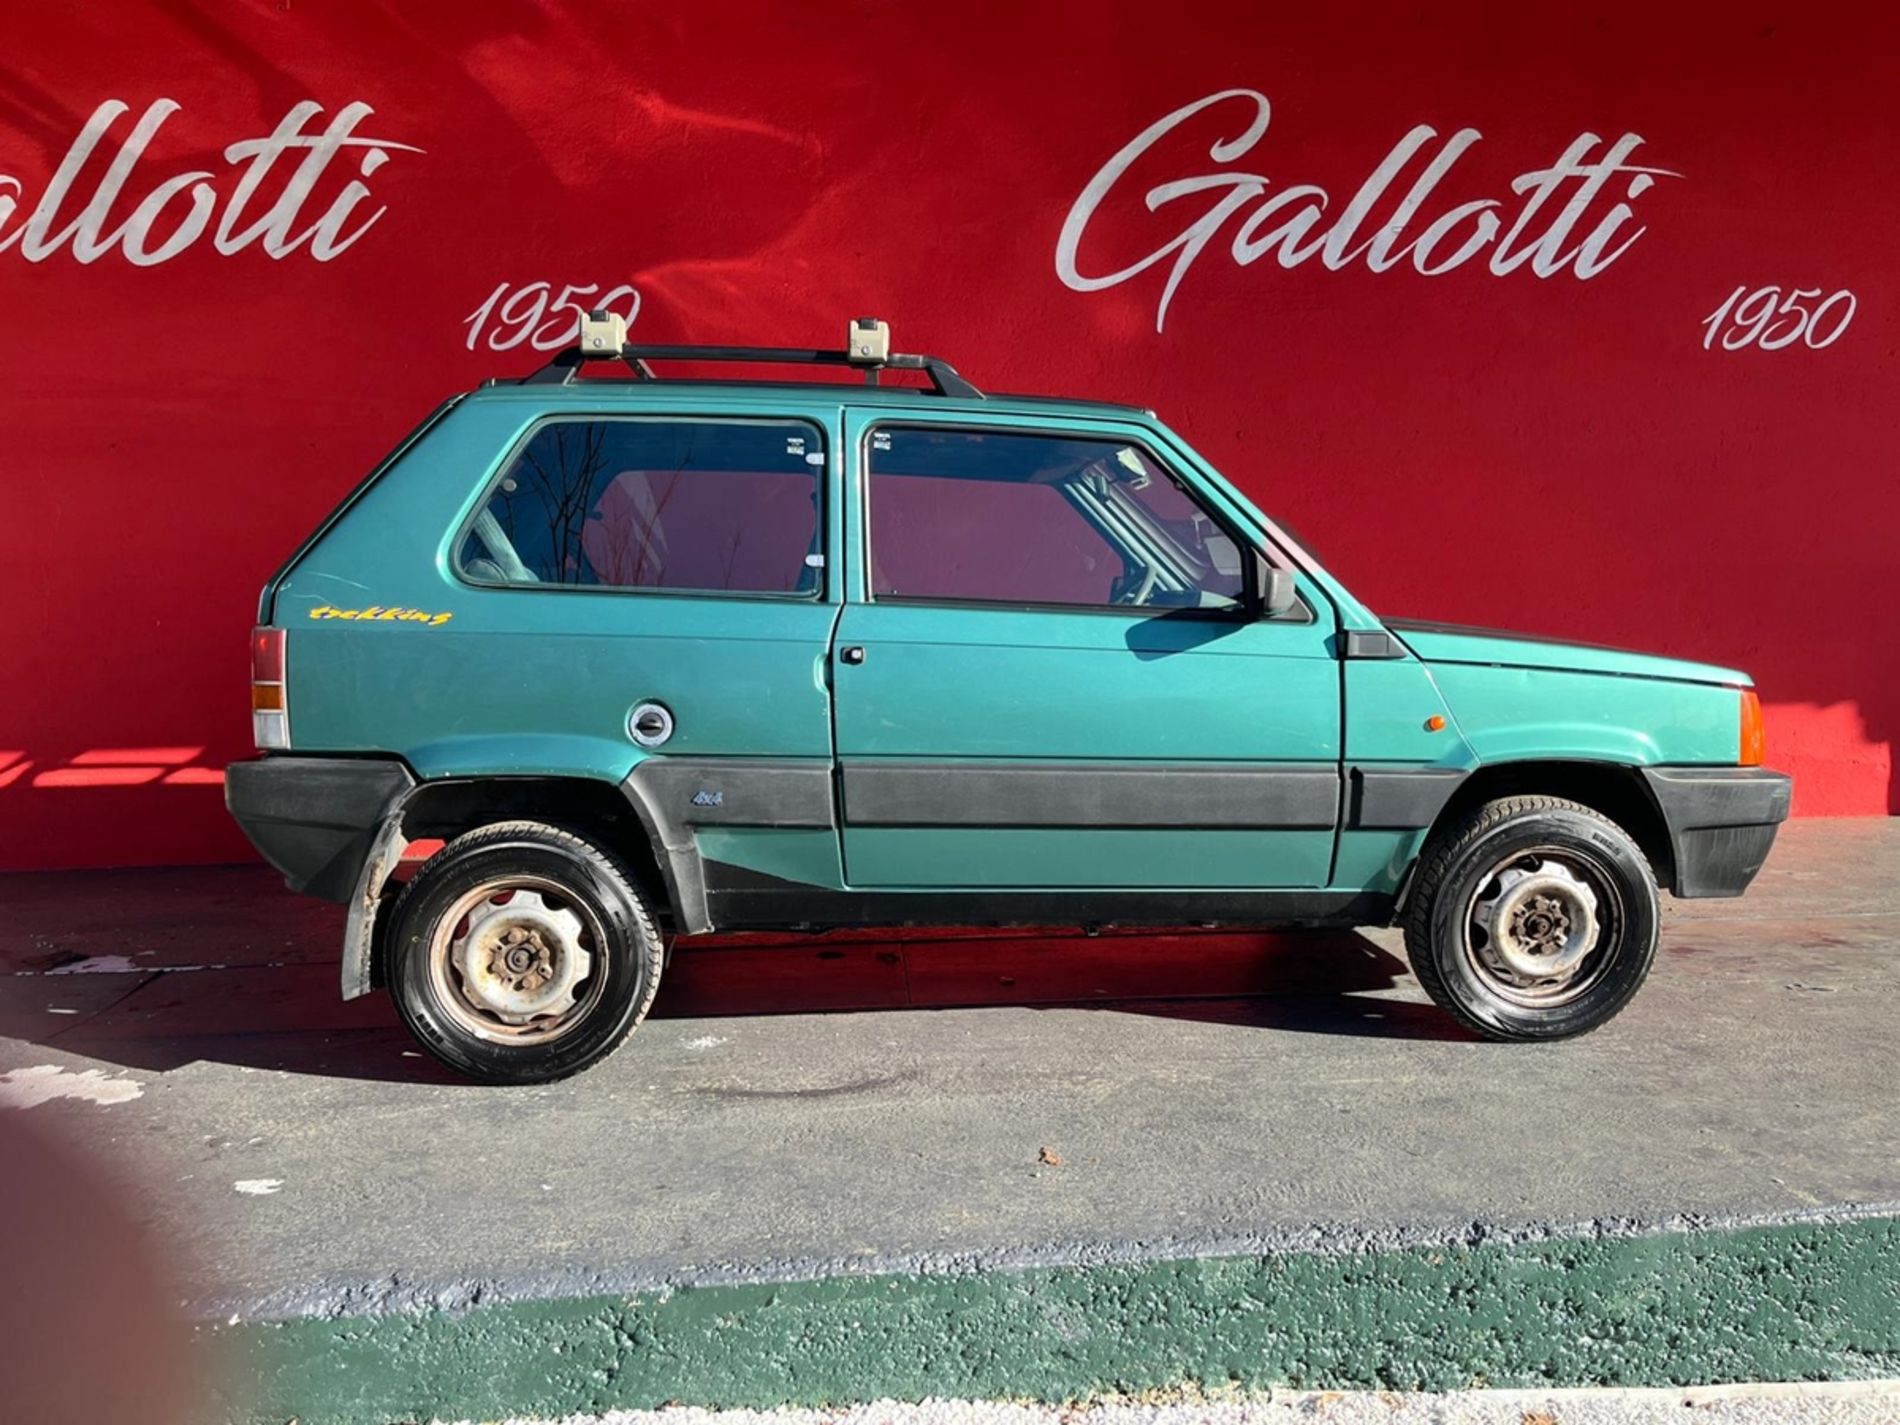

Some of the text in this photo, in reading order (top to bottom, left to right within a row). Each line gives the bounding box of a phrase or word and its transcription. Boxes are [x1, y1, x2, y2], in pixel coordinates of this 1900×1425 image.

[1055, 89, 1688, 334] Gallotti
[1702, 285, 1857, 351] 1950
[309, 605, 453, 627] trekking
